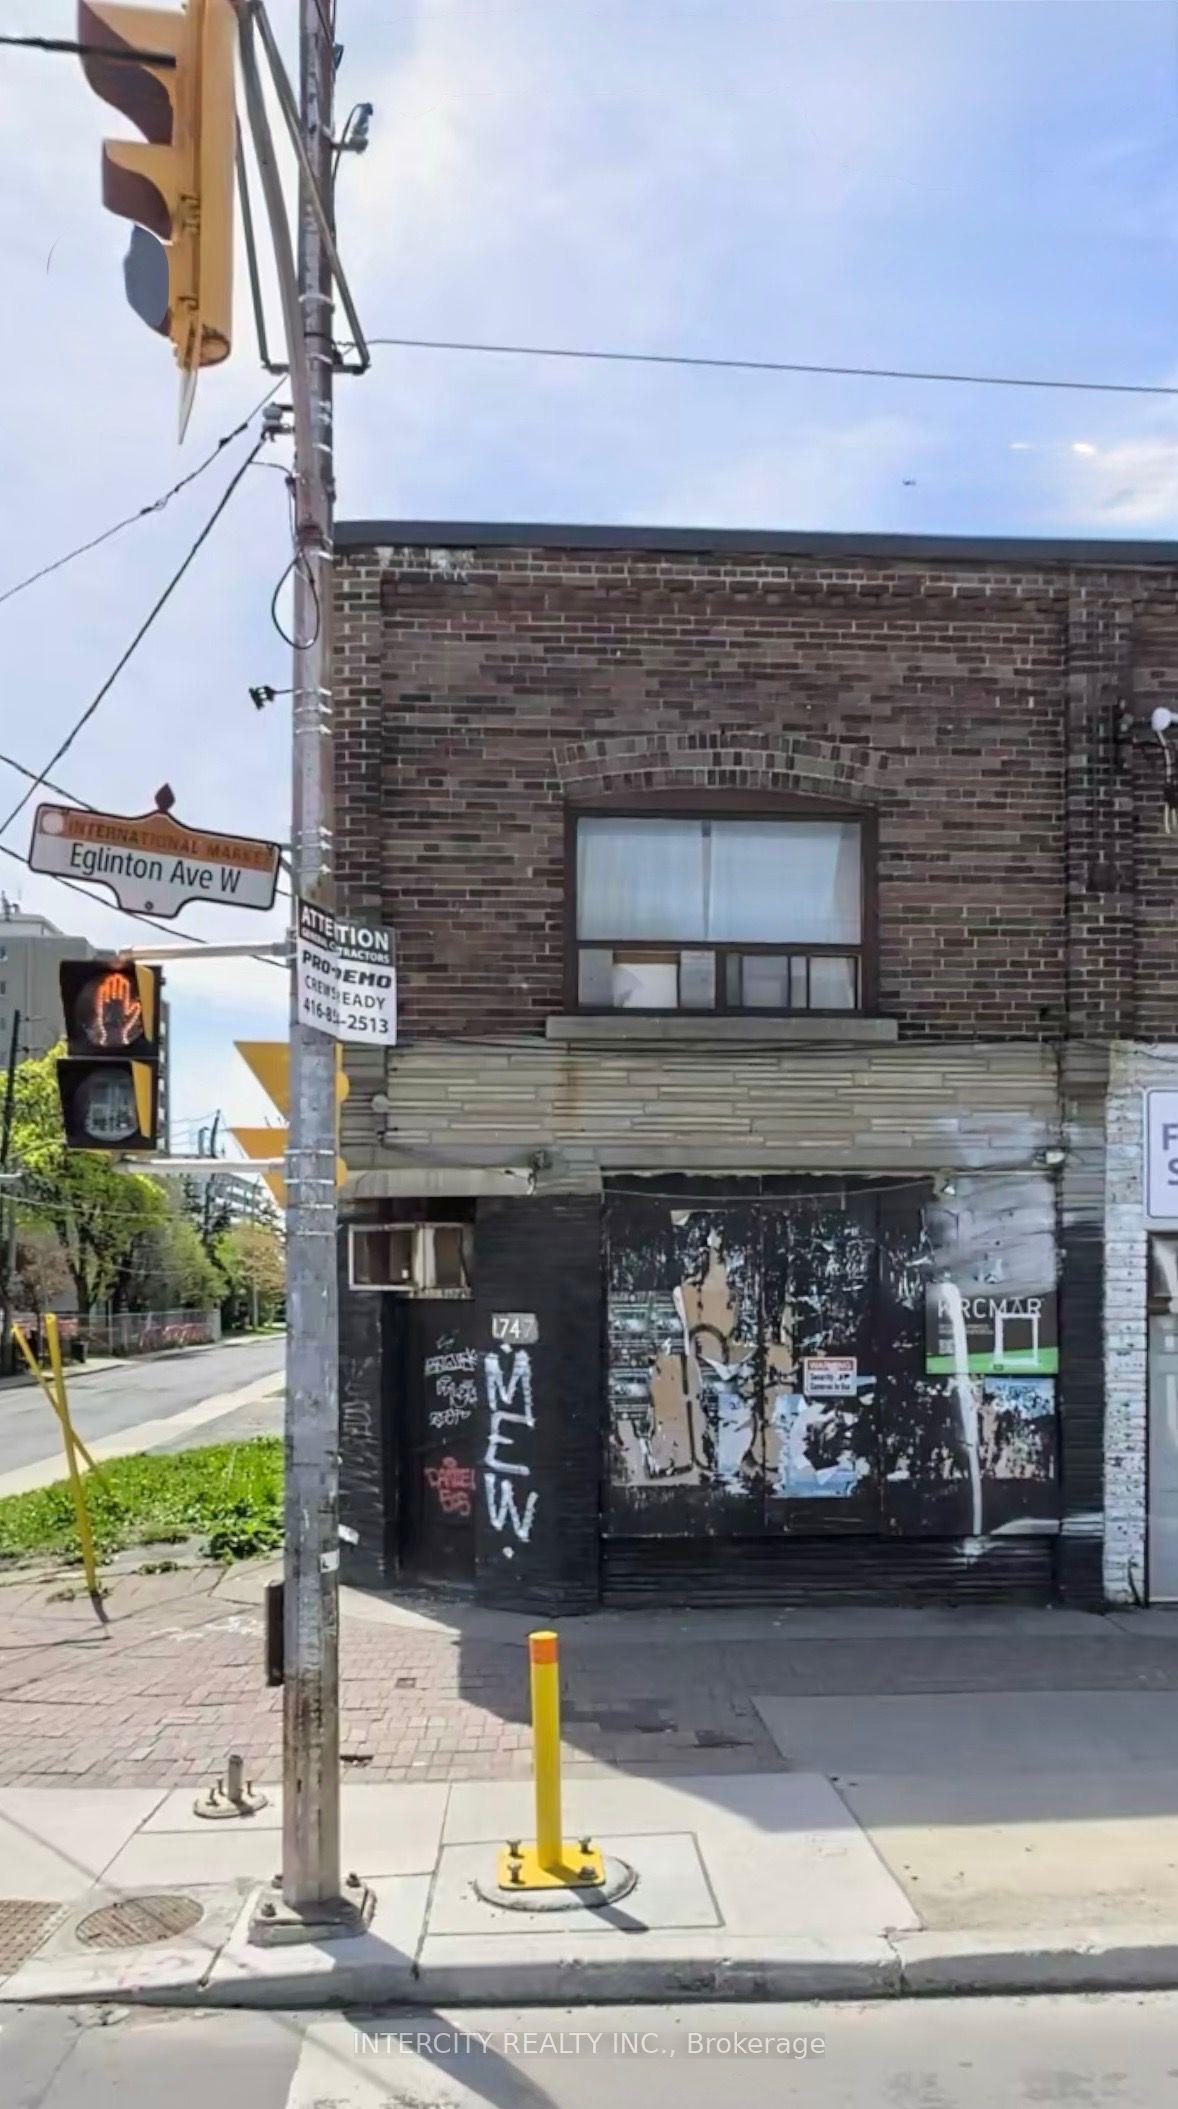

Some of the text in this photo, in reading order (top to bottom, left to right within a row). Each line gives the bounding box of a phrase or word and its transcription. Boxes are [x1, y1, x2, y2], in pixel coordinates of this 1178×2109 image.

[68, 818, 199, 855] INTERNATIONAL
[70, 843, 241, 893] Eglinton Ave W
[493, 1318, 535, 1339] 1747
